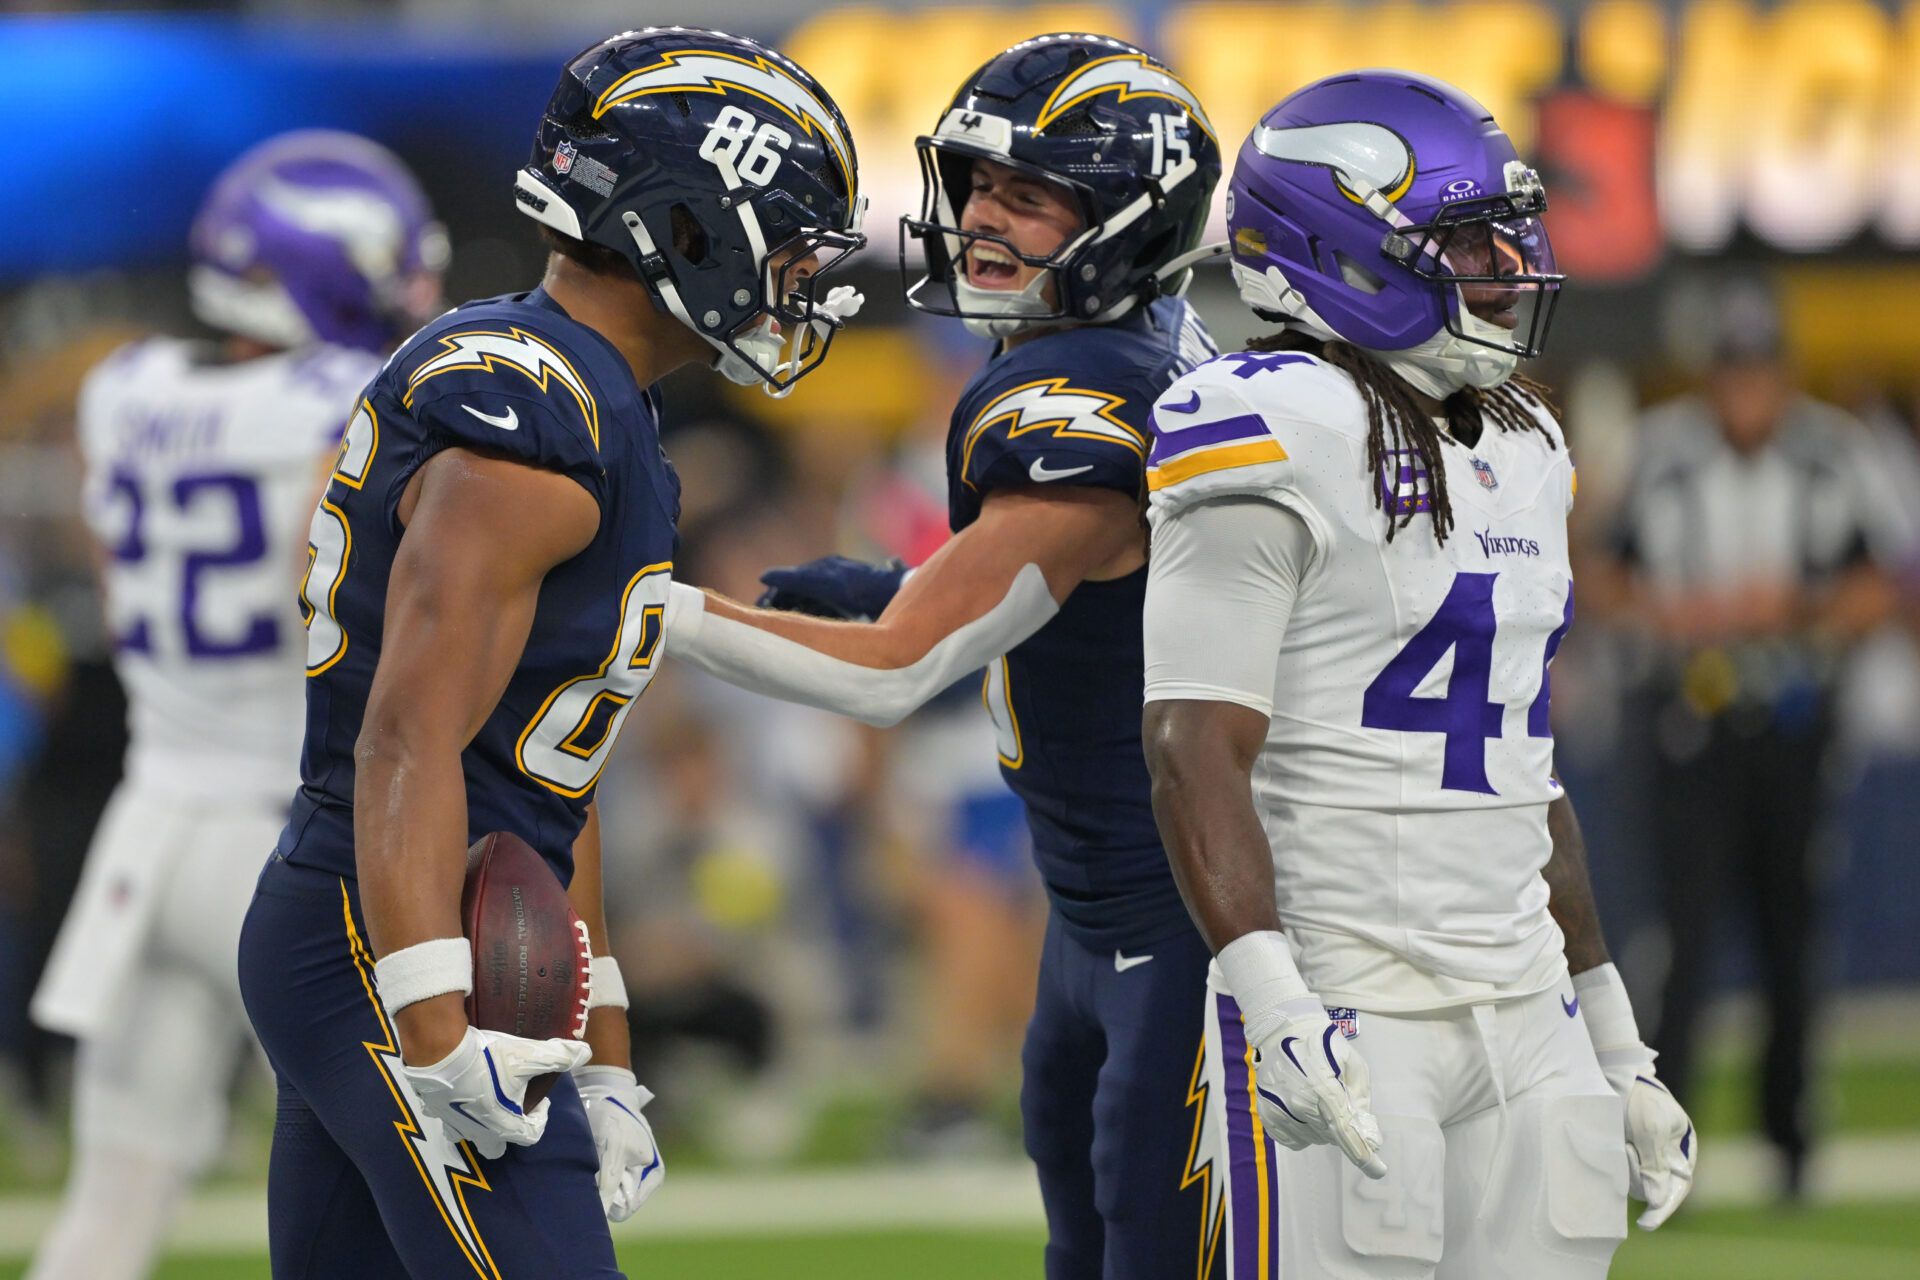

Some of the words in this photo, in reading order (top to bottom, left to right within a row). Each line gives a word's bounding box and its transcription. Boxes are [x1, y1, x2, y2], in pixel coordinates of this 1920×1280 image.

[699, 105, 792, 187] 86
[959, 112, 983, 132] LA
[1148, 112, 1194, 176] 15
[555, 153, 571, 170] NFL
[1442, 188, 1482, 202] OAKLEY
[105, 462, 281, 660] 22
[514, 561, 674, 799] 8
[512, 887, 527, 940] NATIONAL
[518, 945, 528, 1008] FOOTBALL
